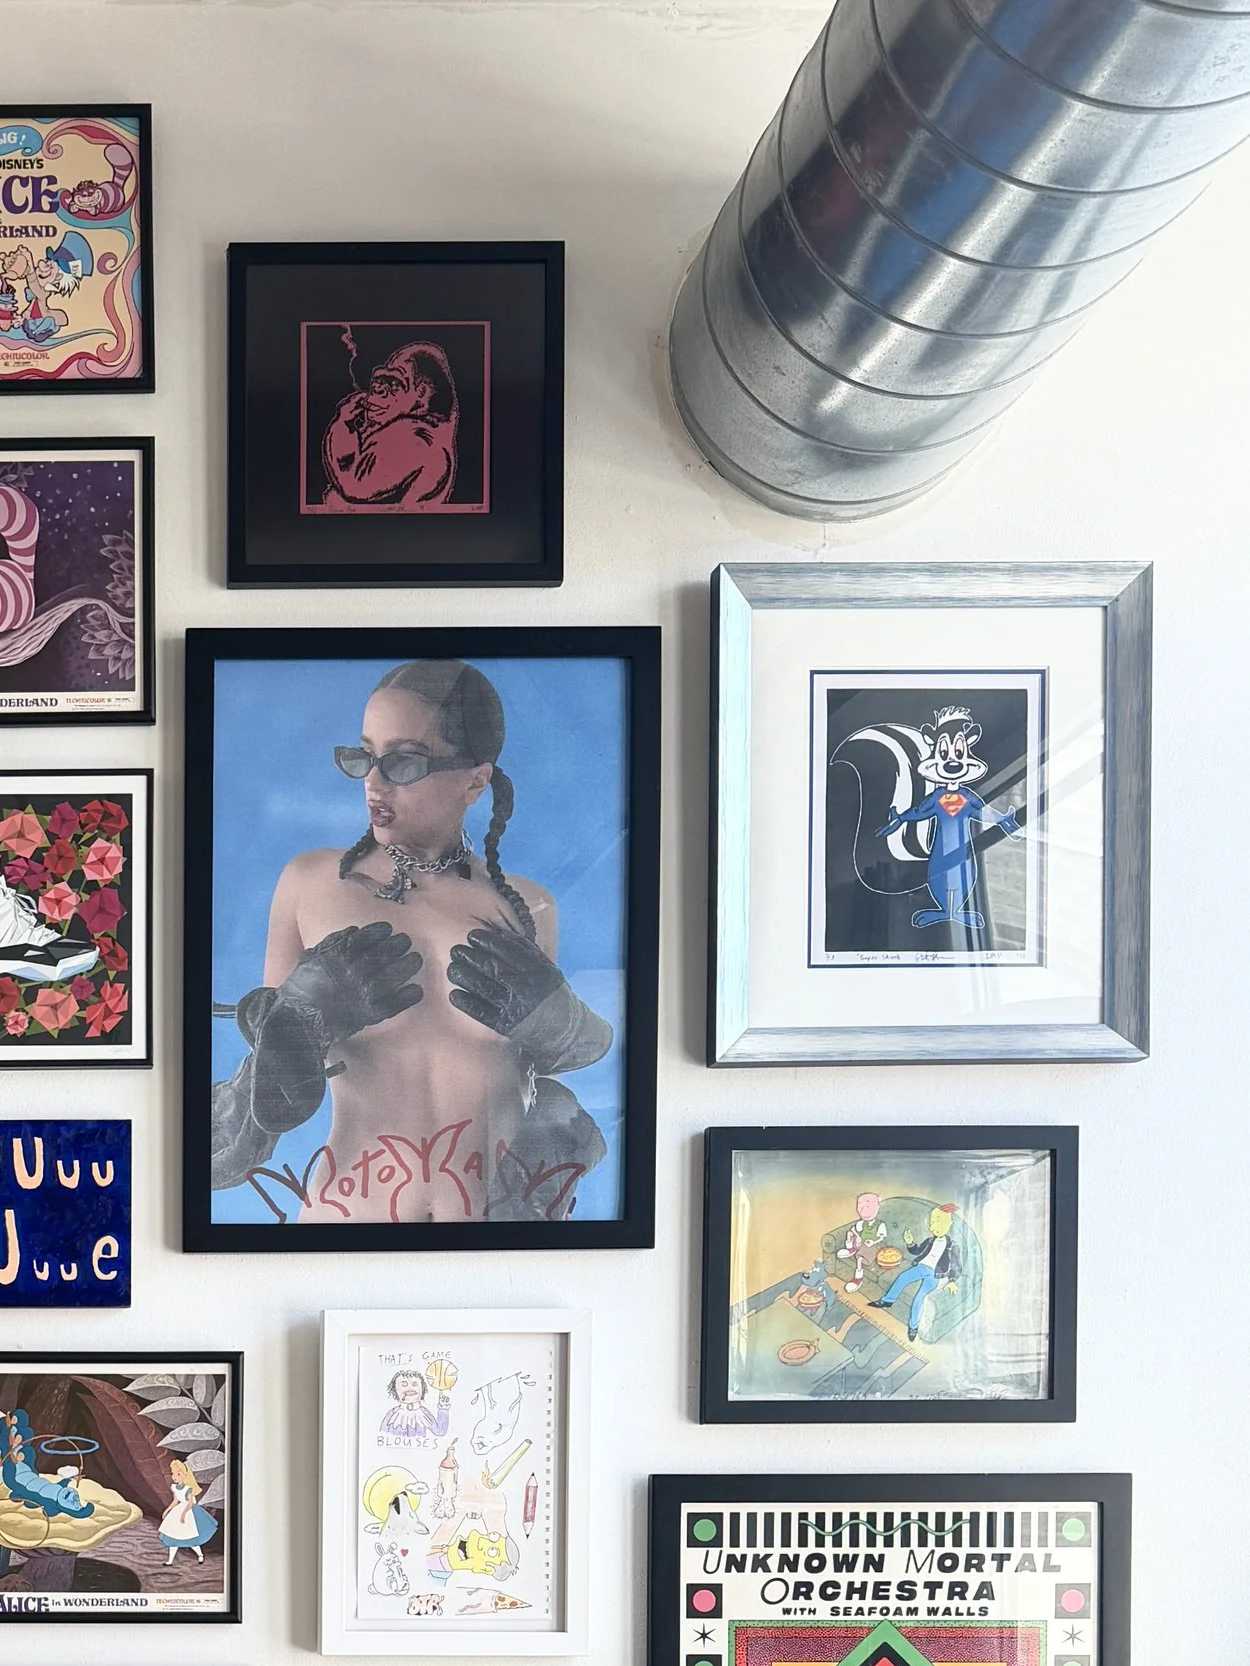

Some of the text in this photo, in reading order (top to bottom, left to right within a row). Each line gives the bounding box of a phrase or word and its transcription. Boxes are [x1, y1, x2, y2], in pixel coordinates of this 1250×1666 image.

[378, 1350, 452, 1365] THAT'S GAME
[377, 1435, 439, 1450] BLOUSES
[702, 1549, 1062, 1575] UNKNOWN MORTAL
[760, 1577, 996, 1605] ORCHESTRA
[52, 1598, 62, 1607] in
[63, 1597, 149, 1607] WONDERLAND
[781, 1606, 990, 1617] WITH SEAFOAM WALLS
